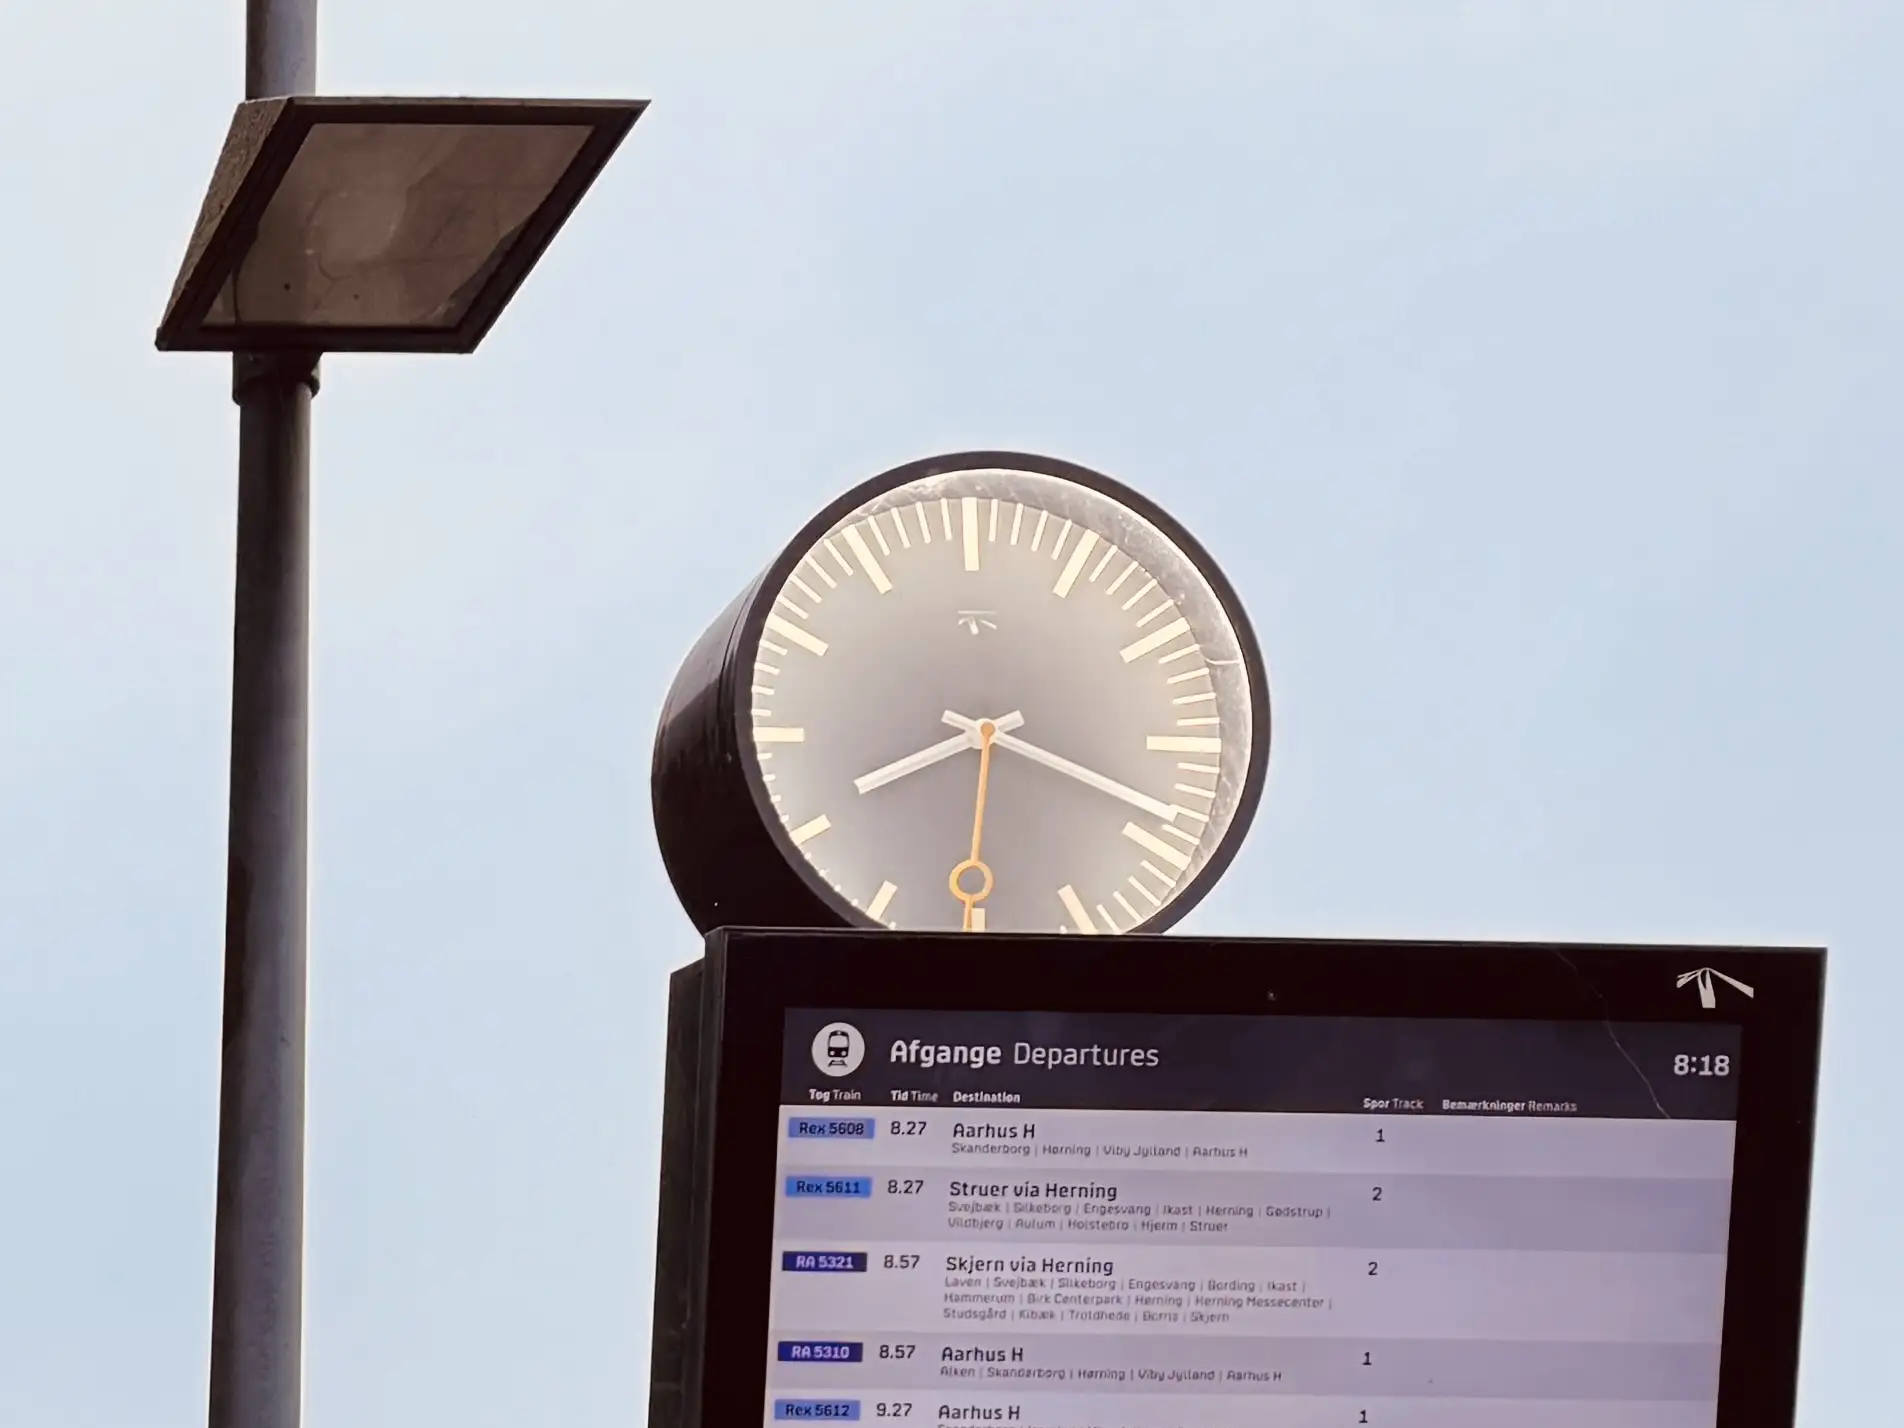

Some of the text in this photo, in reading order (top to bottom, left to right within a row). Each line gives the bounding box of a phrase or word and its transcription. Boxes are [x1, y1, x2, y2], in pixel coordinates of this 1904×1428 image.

[891, 1040, 1158, 1069] Afgange Departures
[1674, 1055, 1729, 1075] 8:18
[809, 1089, 861, 1102] Tog Train
[891, 1090, 938, 1102] Tid Time
[954, 1092, 1020, 1102] Destination
[1364, 1098, 1423, 1109] Spor Track
[800, 1122, 863, 1135] Rex 5608
[891, 1121, 926, 1135] 8.27
[954, 1123, 1034, 1138] Aarhus H
[1377, 1129, 1384, 1142] 1
[797, 1181, 860, 1193] Rex 5611
[888, 1180, 923, 1193] 8.27
[950, 1182, 1116, 1201] Struer via Herning
[1373, 1187, 1382, 1201] 2
[797, 1255, 853, 1271] RA 5321
[884, 1255, 919, 1269] 8.57
[947, 1256, 1113, 1276] Skjern via Herning
[1369, 1262, 1377, 1275] 2
[792, 1344, 849, 1358] RA 5310
[880, 1345, 915, 1358] 8.57
[942, 1347, 1023, 1361] Aarhus H
[1363, 1352, 1371, 1365] 1
[786, 1404, 849, 1416] Rex 5612
[877, 1403, 912, 1416] 9.27
[939, 1405, 1020, 1420] Aarhus H
[1359, 1410, 1367, 1423] 1
